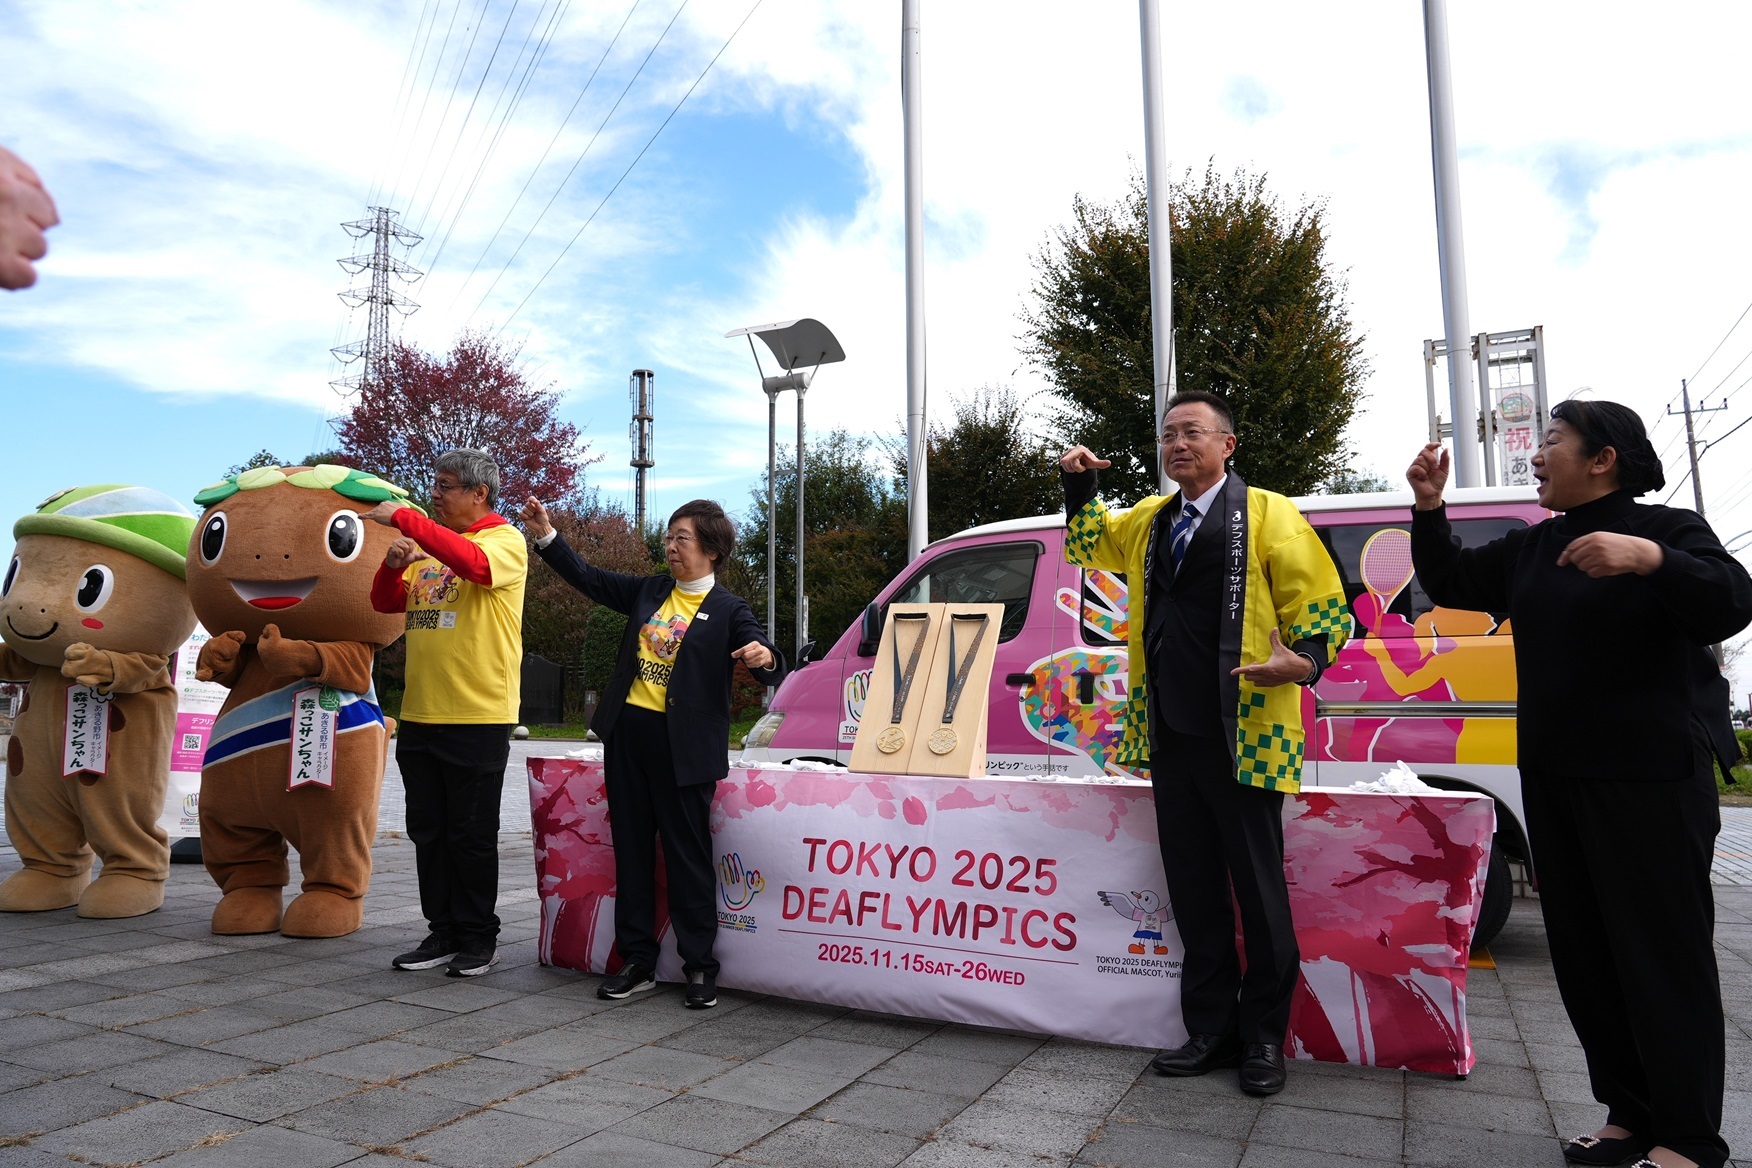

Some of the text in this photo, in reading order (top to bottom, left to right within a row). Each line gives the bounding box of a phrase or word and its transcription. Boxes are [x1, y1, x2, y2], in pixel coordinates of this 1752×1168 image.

[1505, 427, 1533, 452] 祝
[1229, 523, 1243, 620] デフスポーツサポーター
[643, 661, 672, 677] 2025
[70, 692, 88, 768] 森っこサンちゃん
[93, 705, 103, 740] あきる野市
[296, 698, 315, 779] 森っこサンちゃん
[320, 713, 330, 750] あきる野市
[803, 837, 1058, 896] TOKYO 2025
[718, 911, 756, 925] TOKYO 2025
[781, 885, 1078, 951] DEAFLYMPICS
[1096, 955, 1184, 969] TOKYO 2025 DEAFLYMPI
[1097, 965, 1129, 975] OFFICIAL
[1130, 967, 1164, 978] MASCOT,
